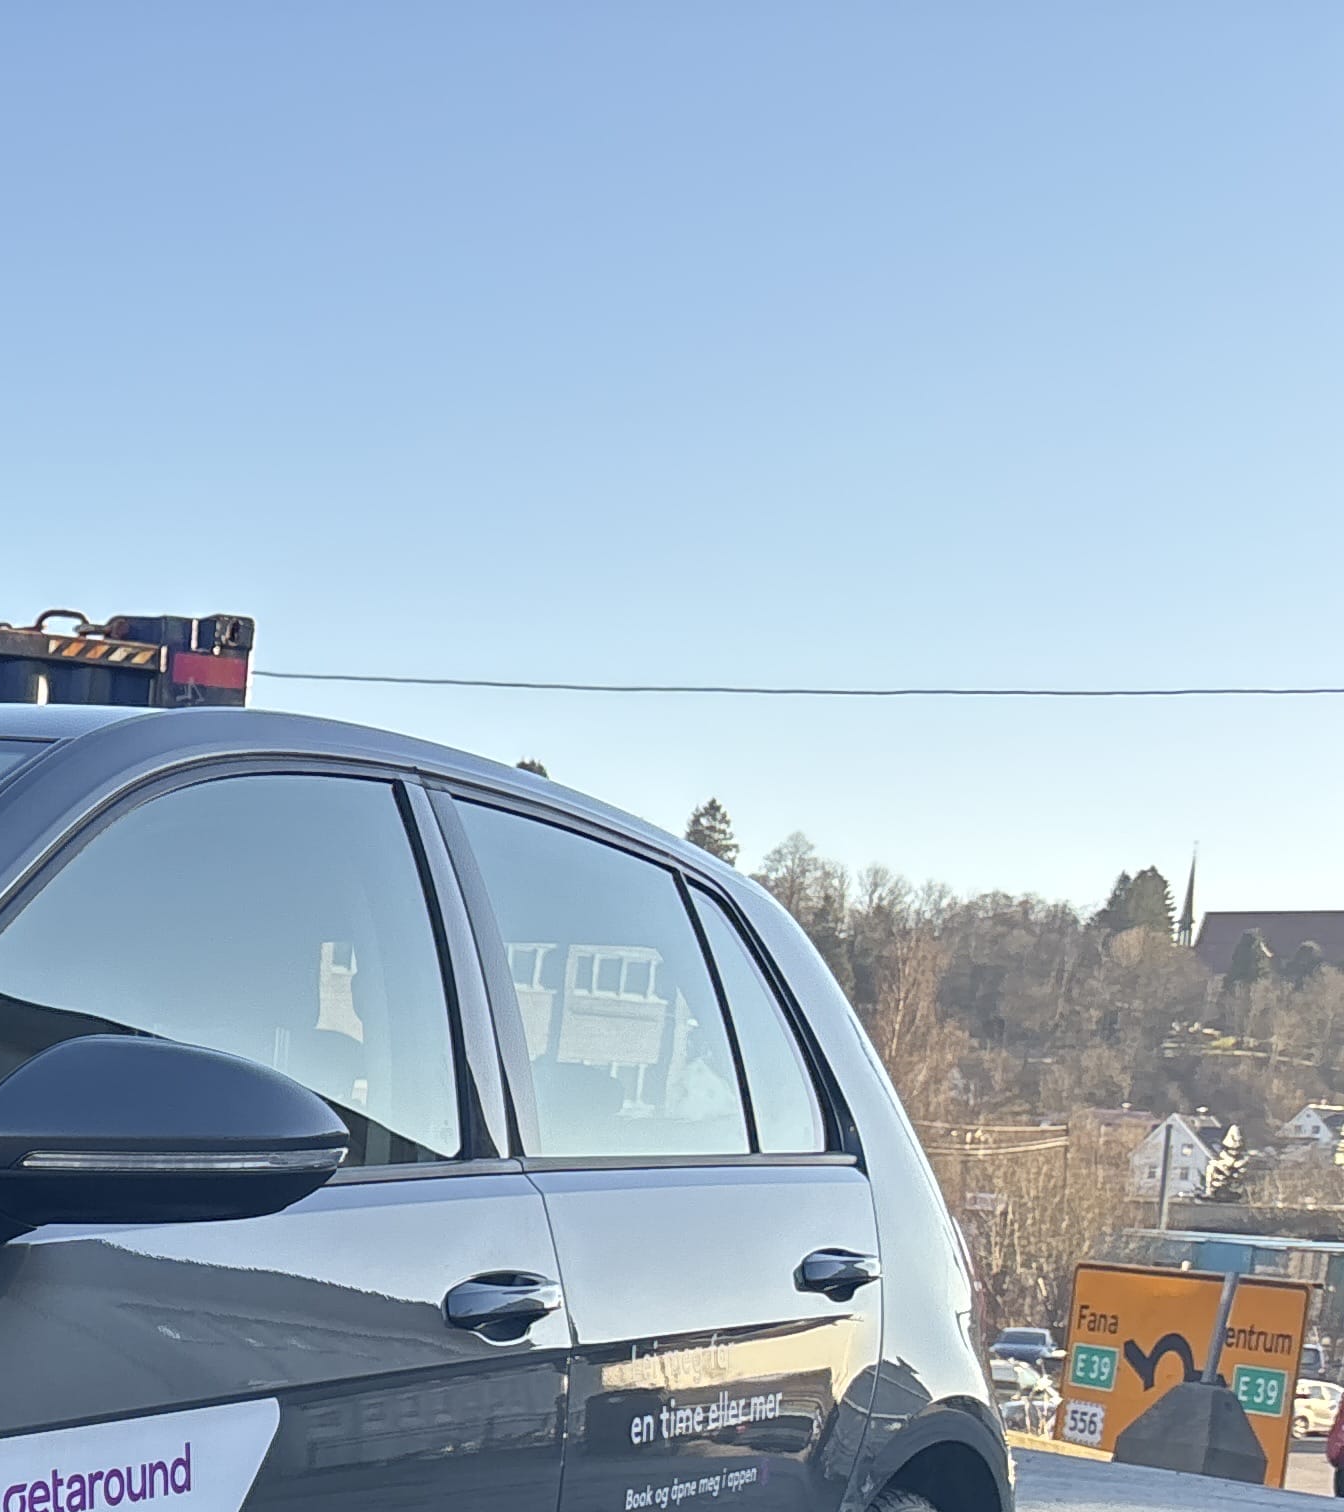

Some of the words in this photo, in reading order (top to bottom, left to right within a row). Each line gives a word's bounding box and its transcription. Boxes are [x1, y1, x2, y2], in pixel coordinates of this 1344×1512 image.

[1076, 1304, 1119, 1335] Fana
[1223, 1323, 1293, 1356] entrum
[1075, 1352, 1088, 1378] E
[1090, 1354, 1111, 1382] 39
[1237, 1377, 1250, 1402] E
[1254, 1378, 1279, 1405] 39
[630, 1414, 654, 1445] en
[660, 1398, 703, 1439] time
[707, 1390, 745, 1430] eller
[750, 1391, 783, 1422] mer
[1069, 1409, 1098, 1436] 556
[625, 1484, 653, 1511] Book
[655, 1486, 669, 1510] og
[671, 1478, 697, 1506] åpne
[698, 1473, 721, 1497] meg
[721, 1467, 727, 1489] i
[728, 1467, 758, 1493] appen
